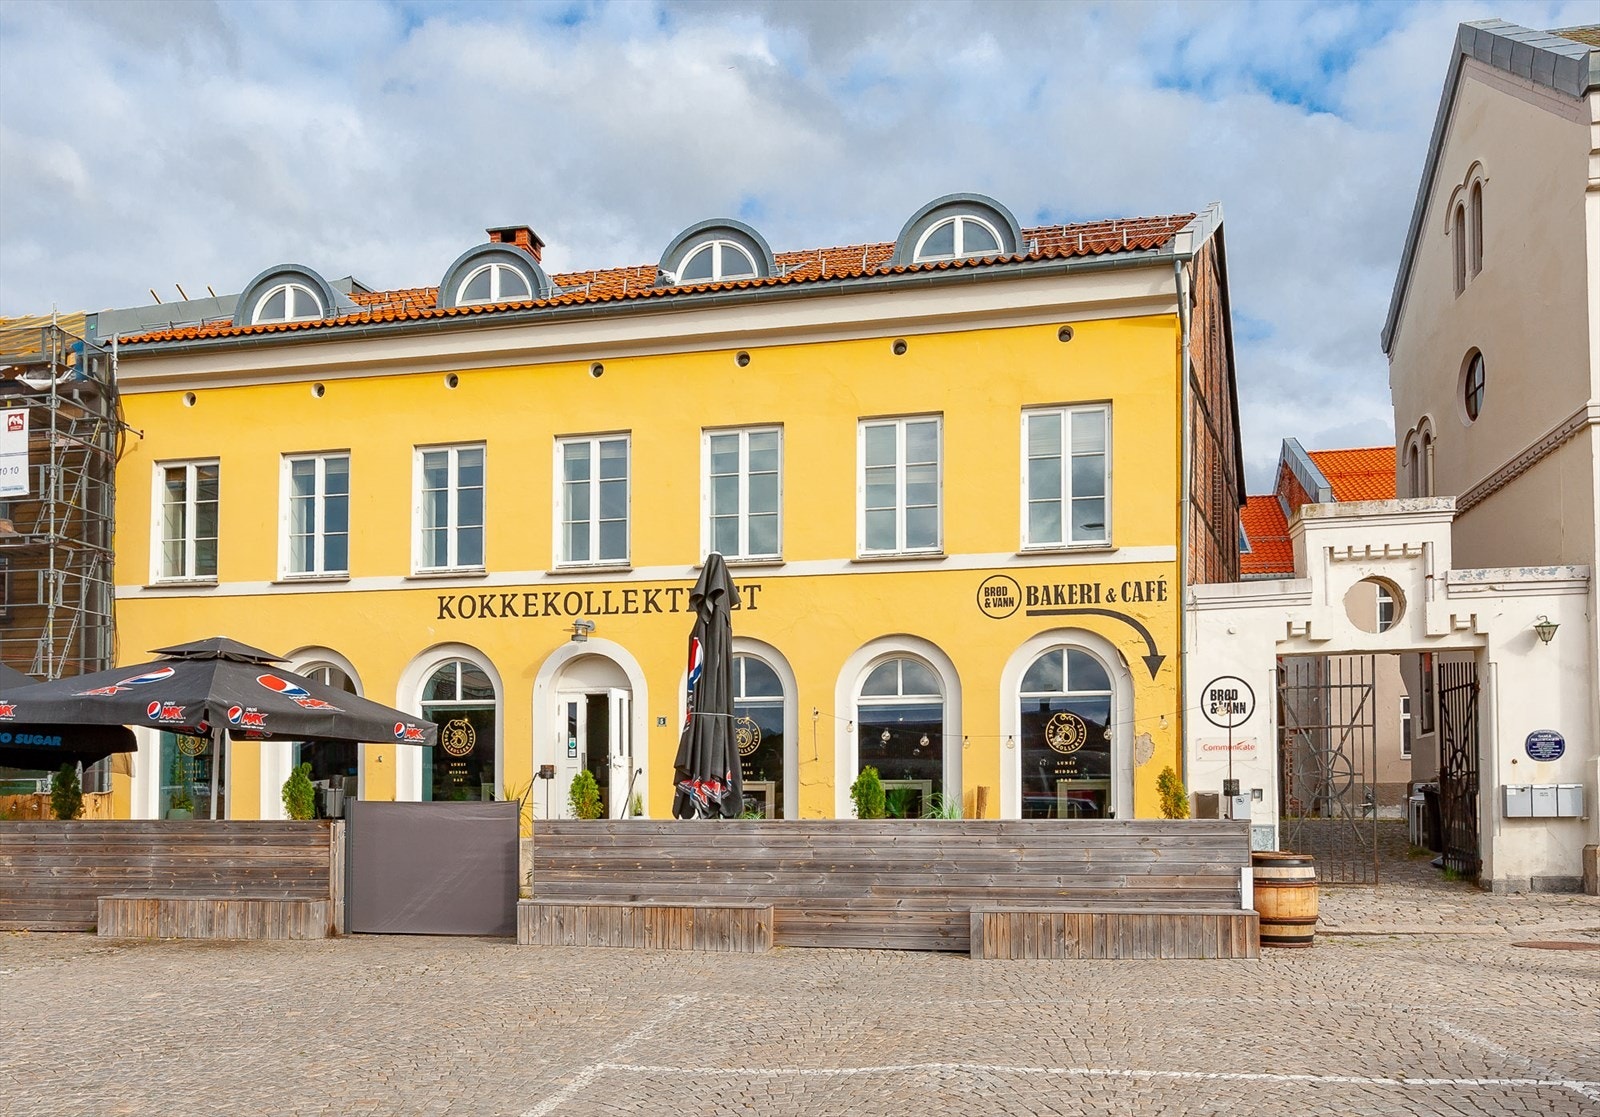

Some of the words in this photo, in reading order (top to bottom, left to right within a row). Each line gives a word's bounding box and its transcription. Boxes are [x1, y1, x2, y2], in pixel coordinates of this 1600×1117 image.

[10, 466, 19, 475] 10
[984, 586, 1008, 597] BRØD
[1026, 583, 1101, 606] BAKERI
[1105, 588, 1117, 603] &
[1121, 575, 1168, 603] CAFÉ
[437, 585, 762, 619] KOKKEKOLLEKTT
[984, 598, 992, 608] &
[993, 597, 1014, 608] VANN
[1210, 689, 1238, 701] BRØD
[160, 706, 186, 719] MAX
[241, 712, 268, 725] MAX
[0, 732, 12, 743] O
[15, 733, 62, 746] SUGAR
